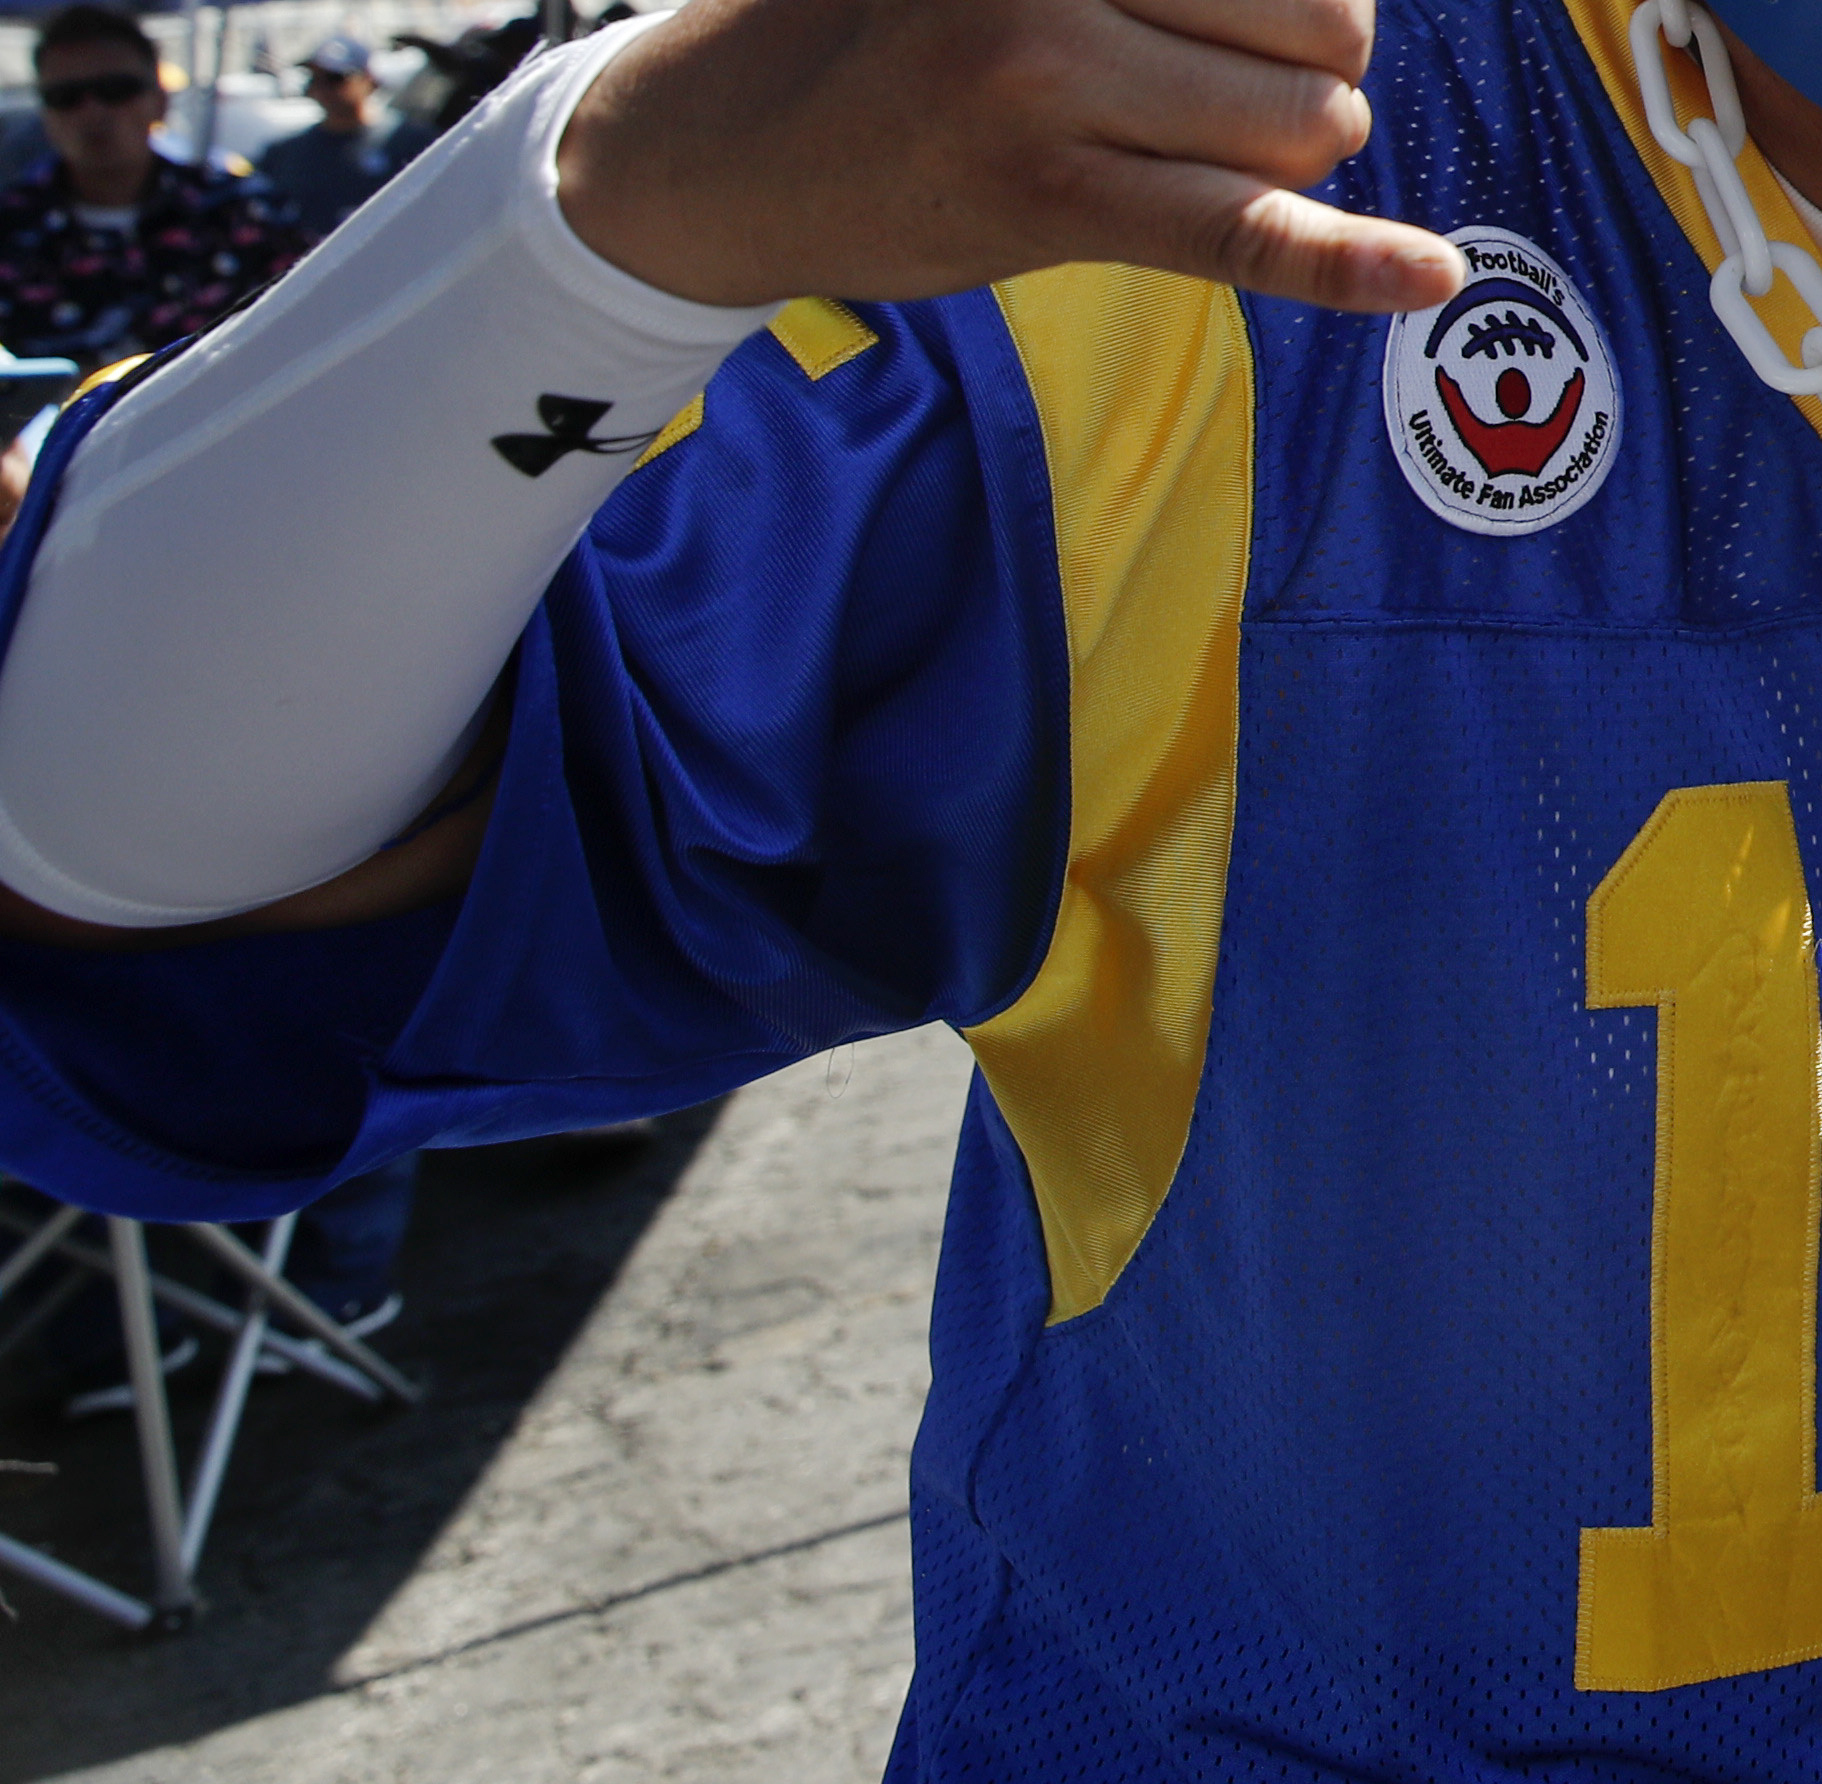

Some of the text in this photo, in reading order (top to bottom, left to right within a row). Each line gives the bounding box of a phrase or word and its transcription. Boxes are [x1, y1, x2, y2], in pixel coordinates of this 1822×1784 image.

[1464, 247, 1566, 307] Football's
[1408, 408, 1609, 511] Ultimate Fan Association
